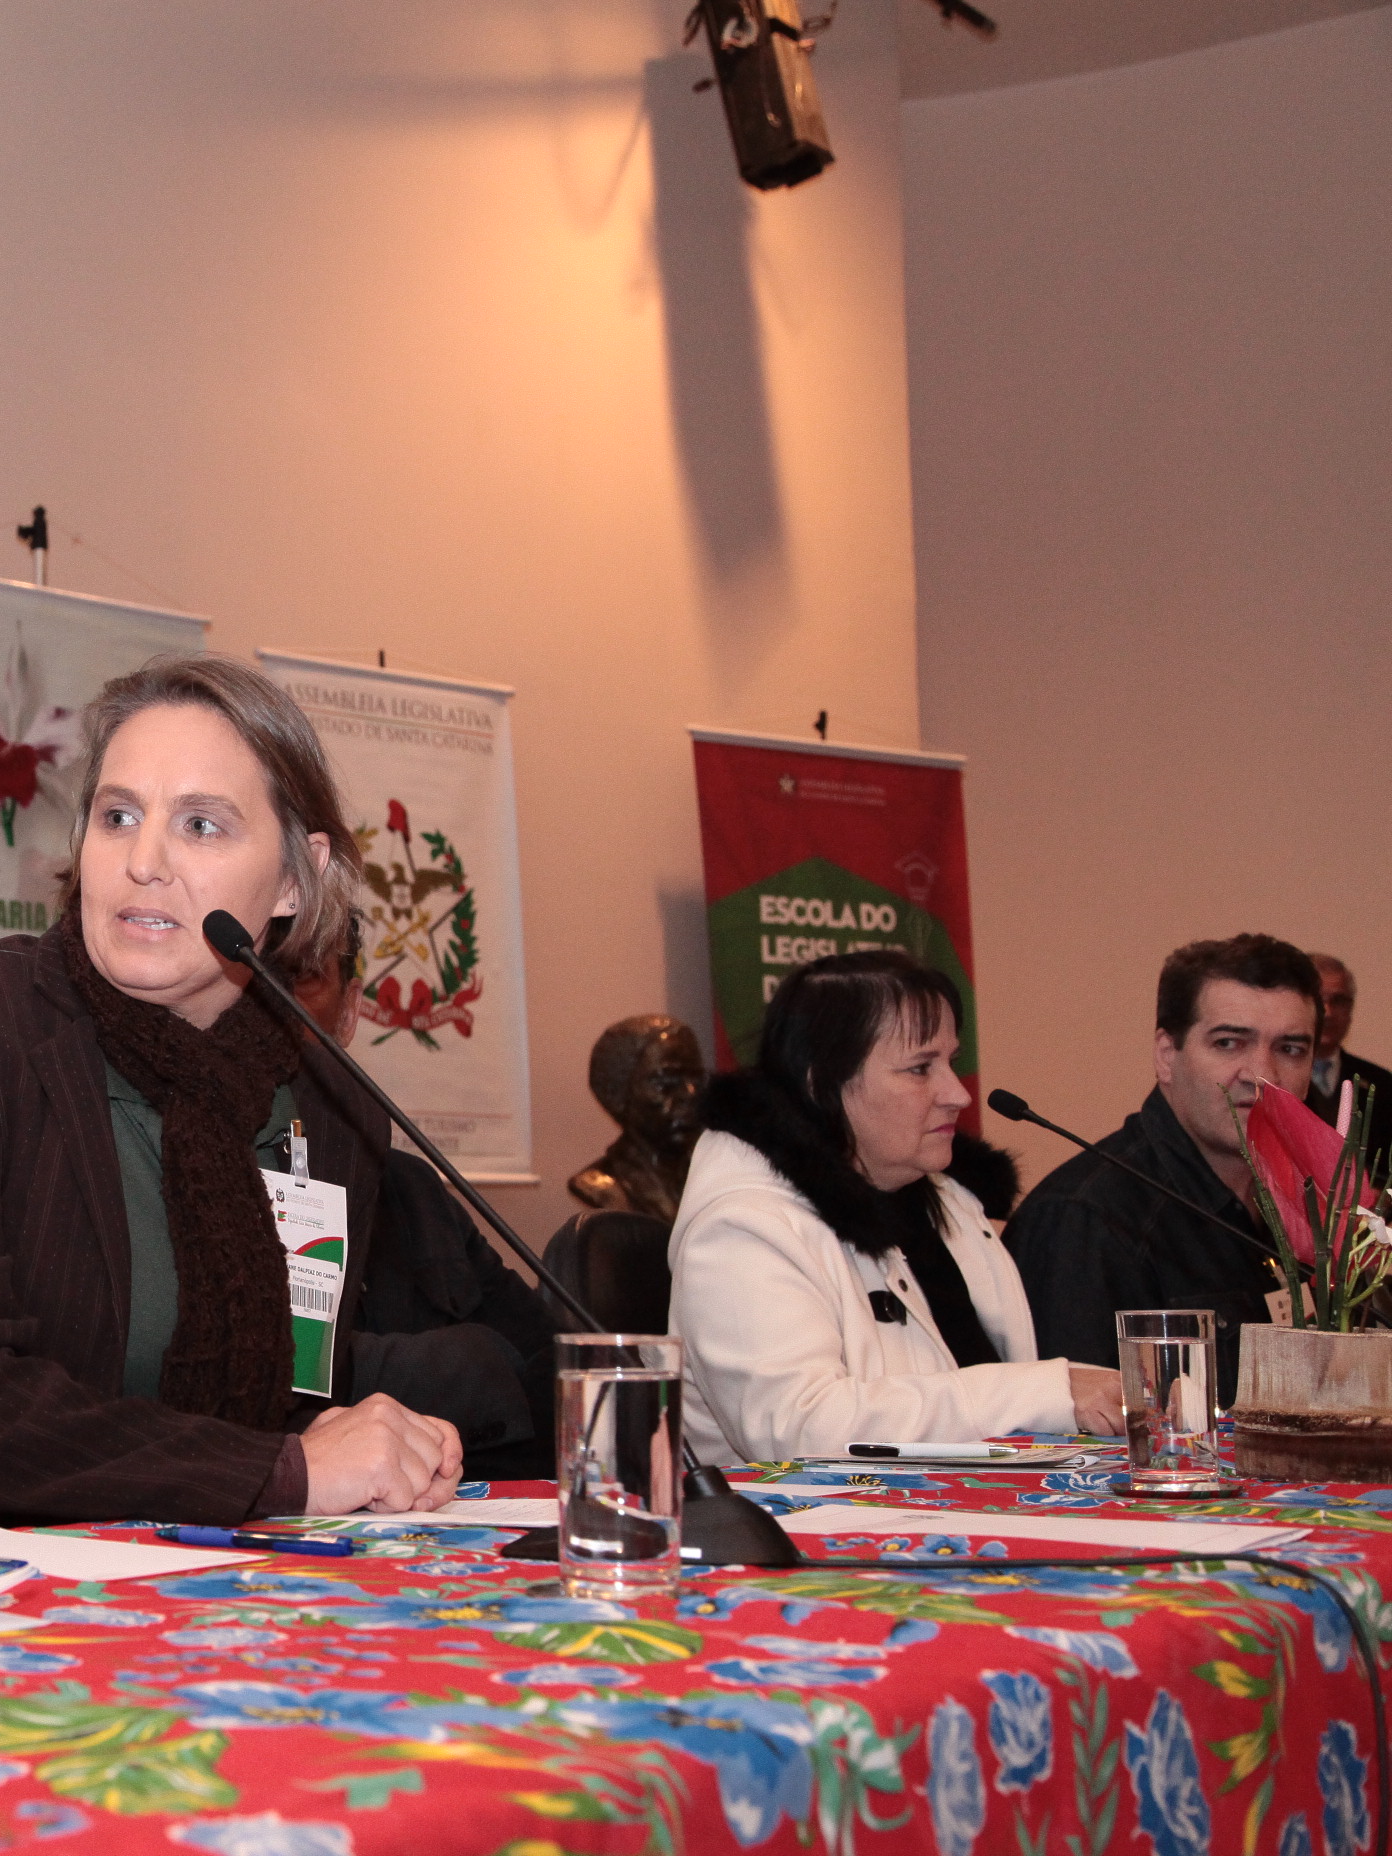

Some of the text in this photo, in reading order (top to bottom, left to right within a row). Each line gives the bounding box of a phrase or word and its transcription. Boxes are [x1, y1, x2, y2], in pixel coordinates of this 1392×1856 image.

[284, 682, 494, 730] ASSEMBLEIA LEGISLATIVA
[759, 894, 898, 933] ESCOLA DO
